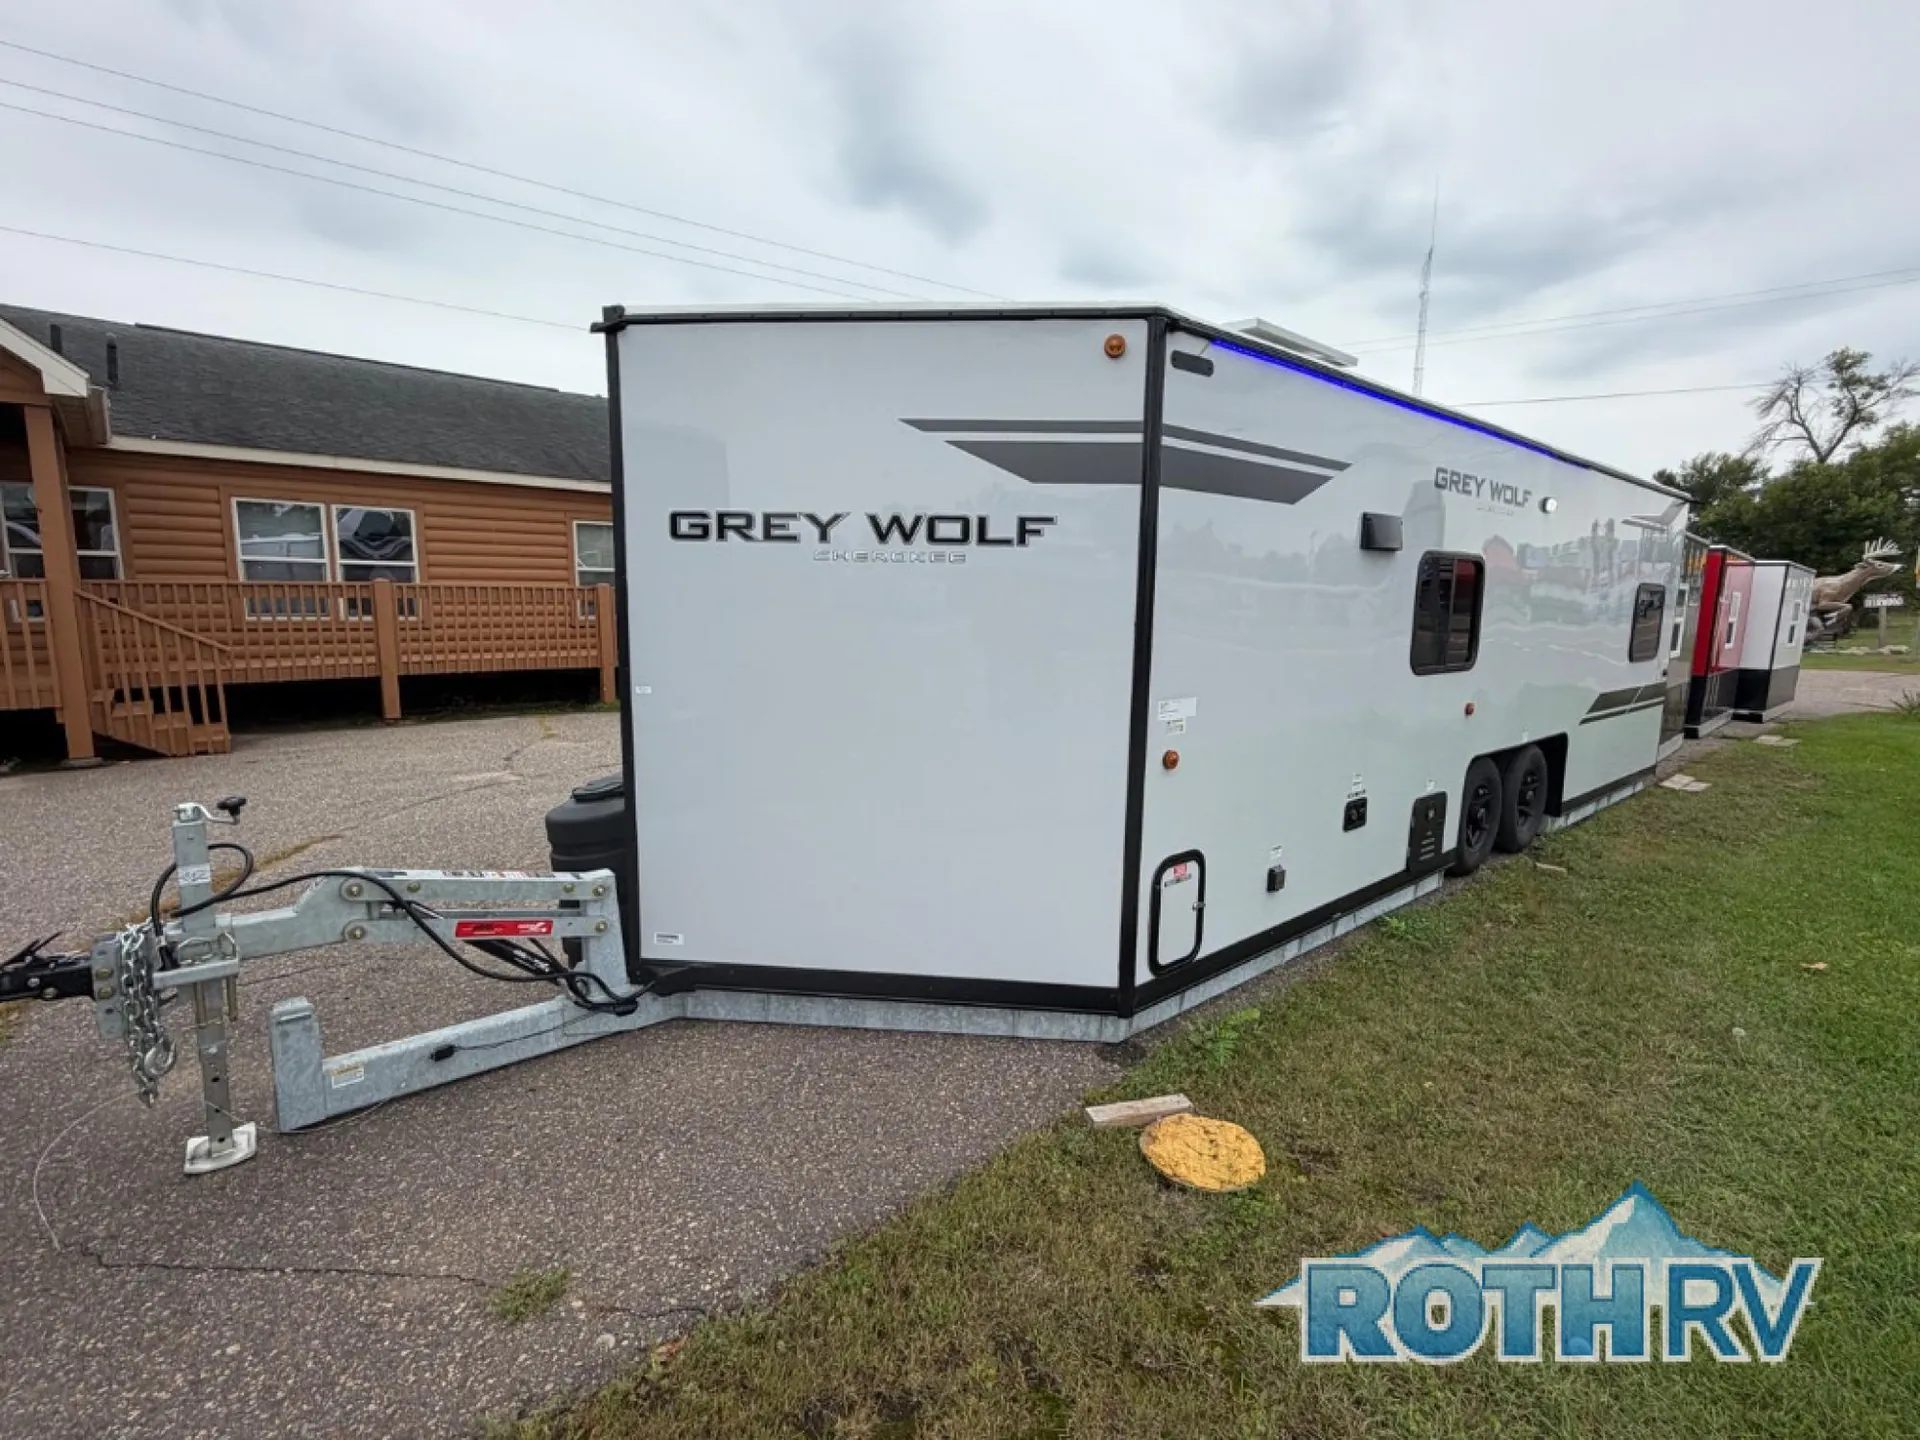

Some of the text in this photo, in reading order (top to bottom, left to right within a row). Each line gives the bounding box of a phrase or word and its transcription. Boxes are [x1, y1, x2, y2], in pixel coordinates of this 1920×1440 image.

[1434, 466, 1532, 508] GREY WOLF
[669, 511, 1057, 547] GREY WOLF
[812, 550, 967, 564] CHEROKEE
